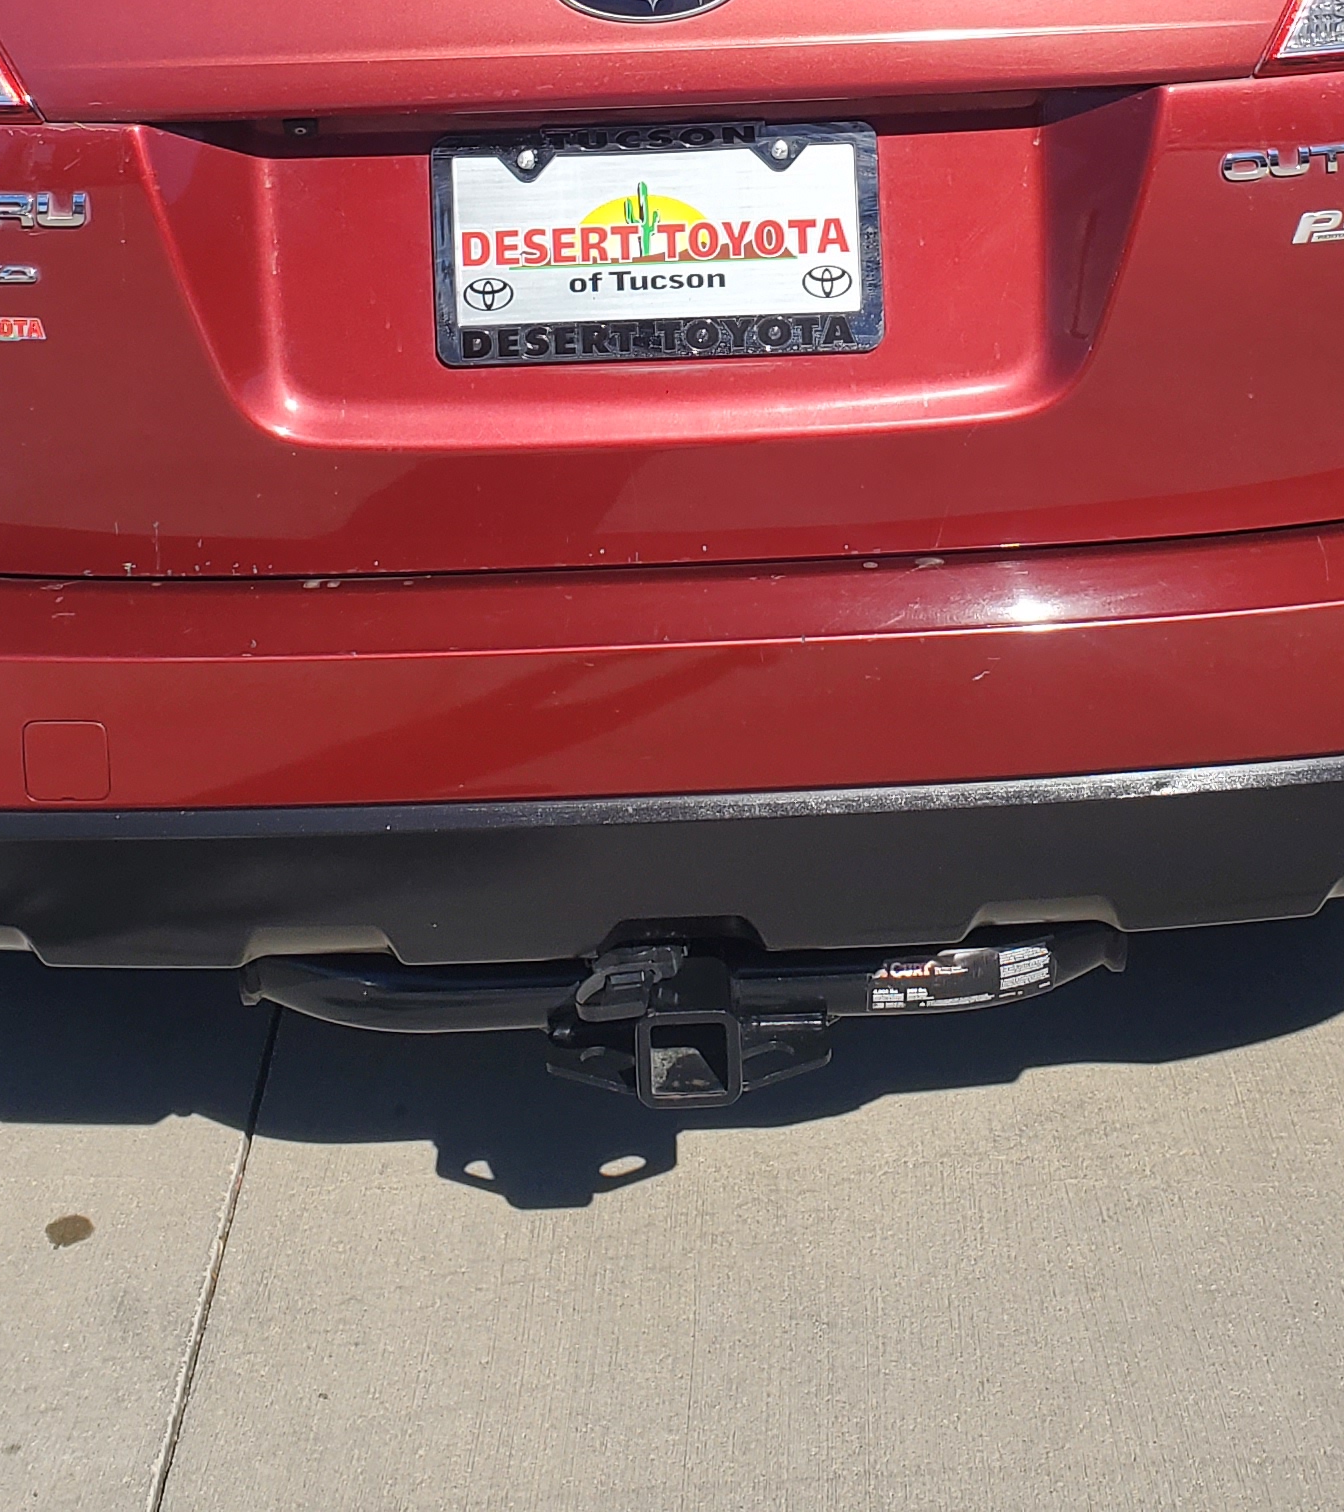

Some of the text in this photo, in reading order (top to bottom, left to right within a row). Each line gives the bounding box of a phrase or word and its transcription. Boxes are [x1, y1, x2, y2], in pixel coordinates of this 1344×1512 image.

[544, 124, 757, 151] TUCSON
[460, 217, 851, 267] DESERT TOYOTA
[569, 271, 726, 294] of Tucson
[461, 316, 857, 360] DESERT TOYOTA
